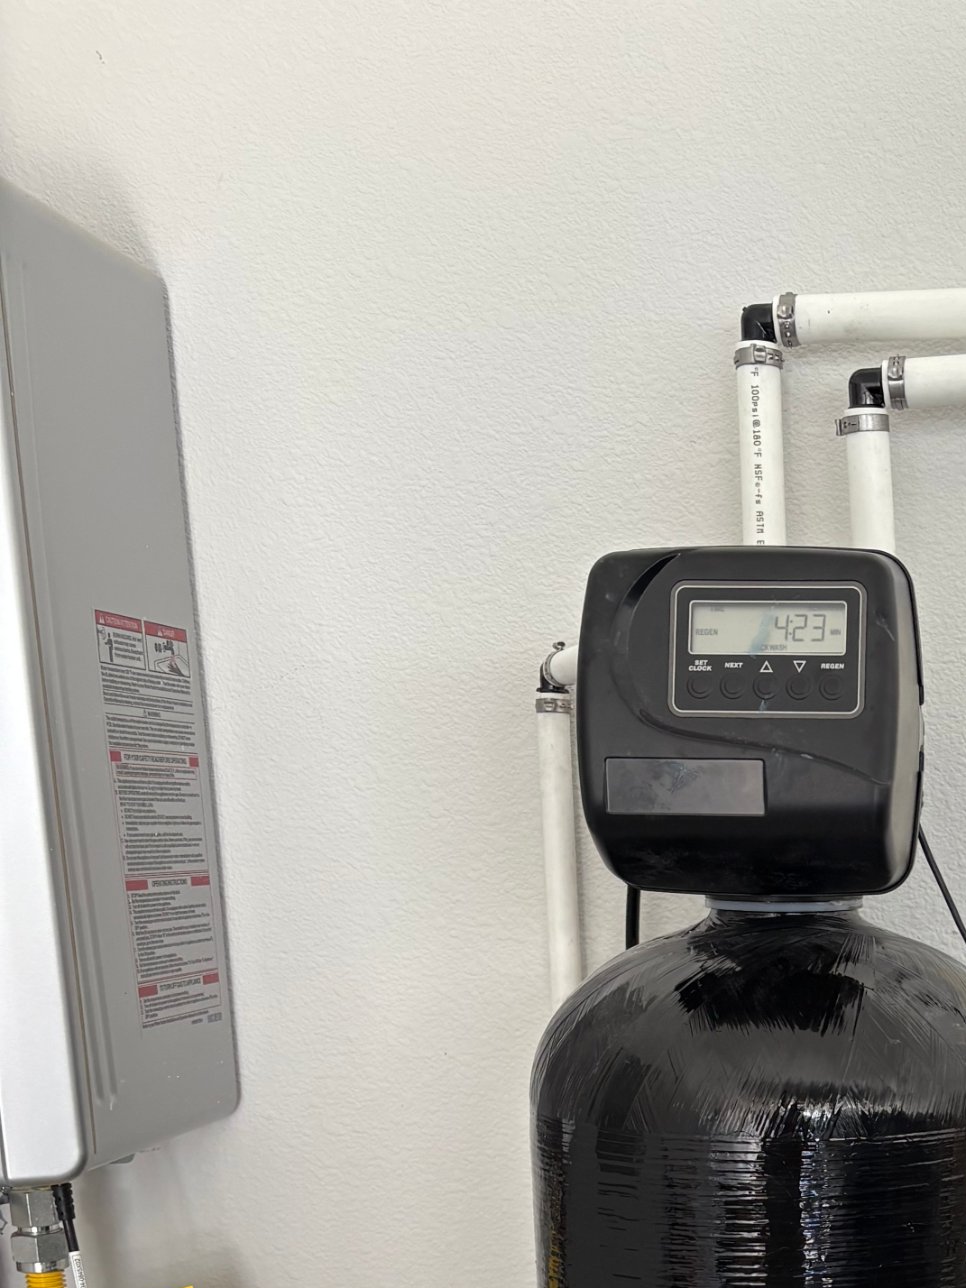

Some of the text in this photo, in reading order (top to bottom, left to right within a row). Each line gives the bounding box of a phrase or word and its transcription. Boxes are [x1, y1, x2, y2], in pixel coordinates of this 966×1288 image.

[756, 511, 765, 534] ASTM
[695, 628, 719, 636] REGEN
[775, 614, 827, 642] 4:23
